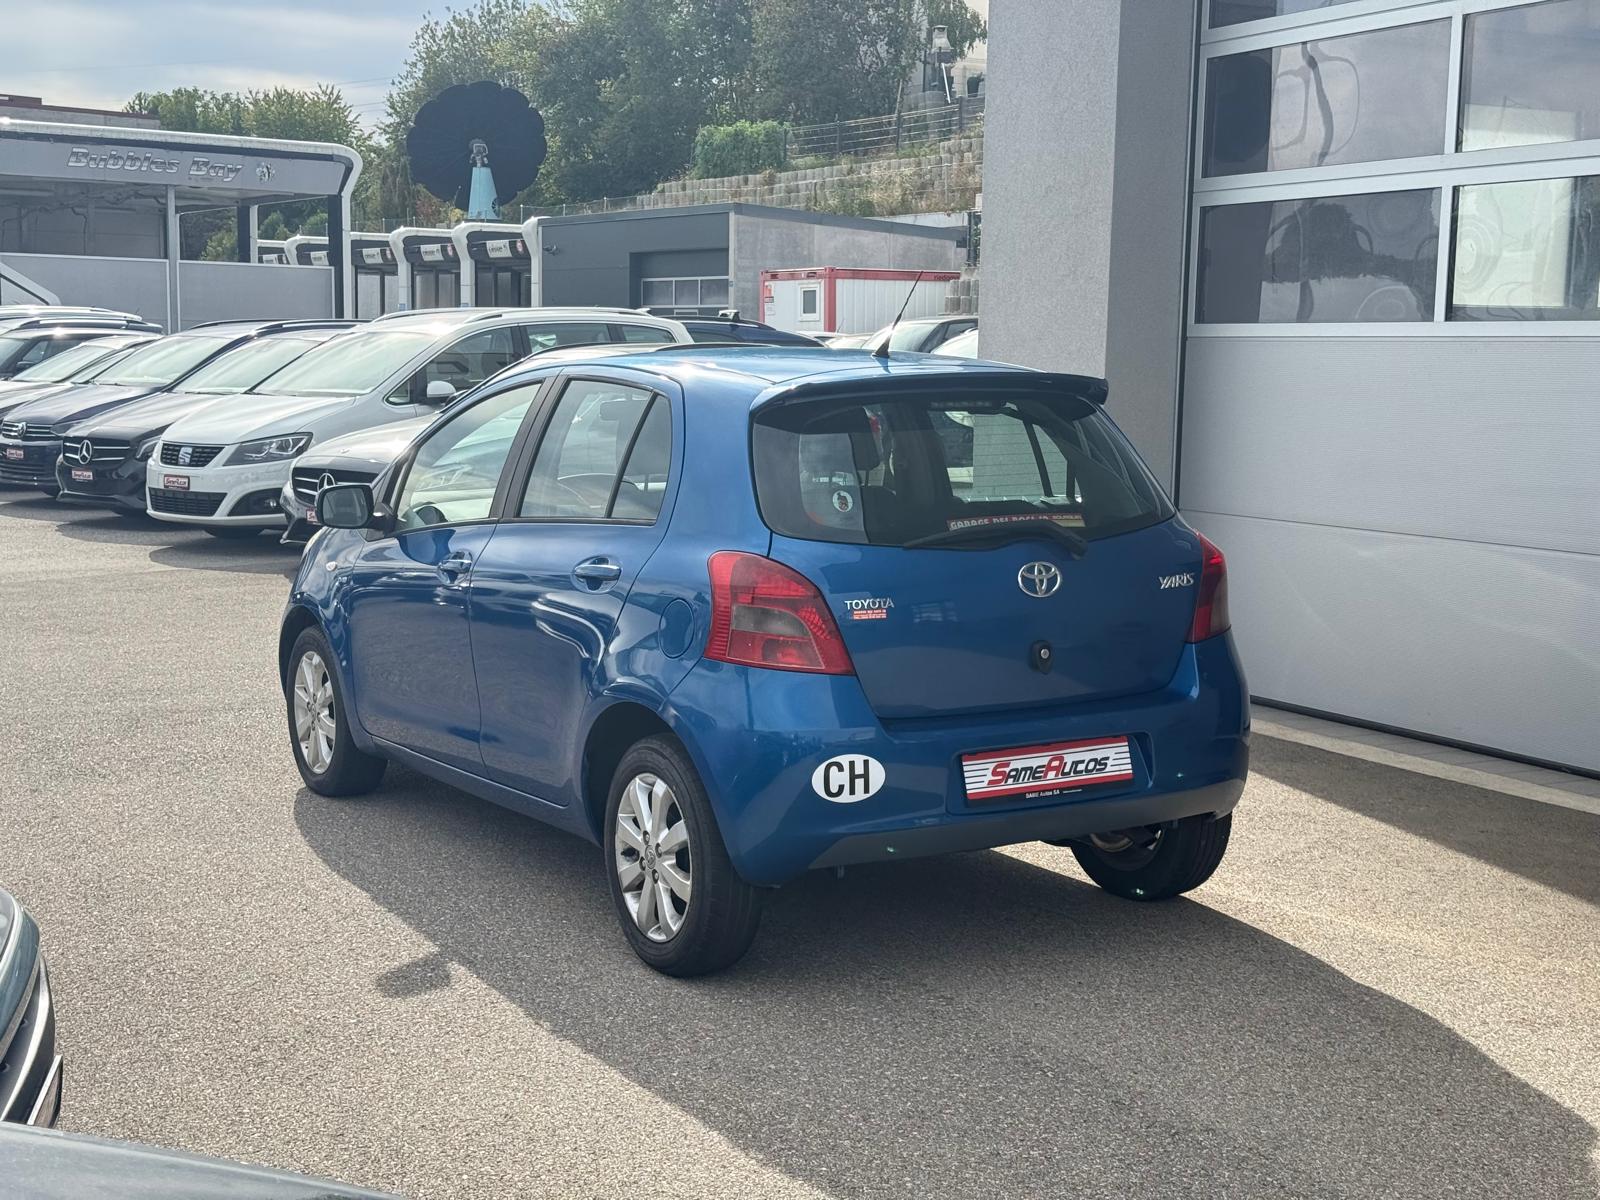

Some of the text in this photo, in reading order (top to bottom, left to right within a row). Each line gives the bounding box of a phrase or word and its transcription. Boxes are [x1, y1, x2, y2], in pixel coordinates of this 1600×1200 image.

[67, 147, 244, 182] Bubbles Bay
[844, 597, 895, 610] TOYOTA
[823, 759, 870, 798] CH
